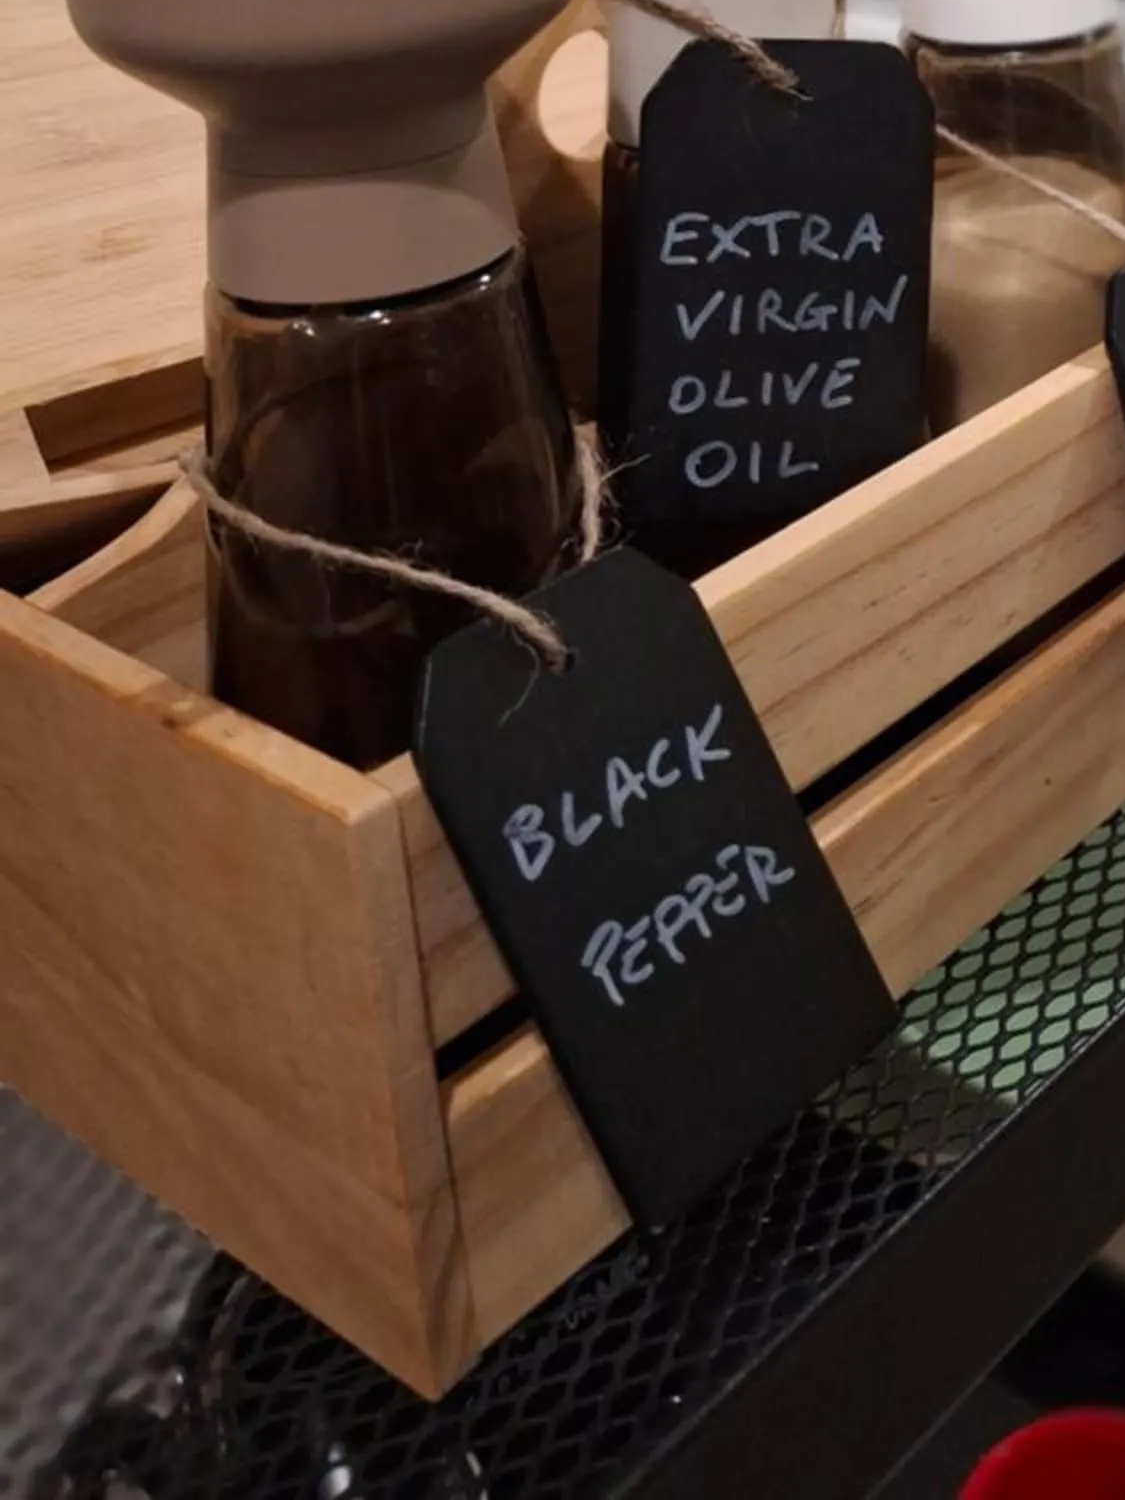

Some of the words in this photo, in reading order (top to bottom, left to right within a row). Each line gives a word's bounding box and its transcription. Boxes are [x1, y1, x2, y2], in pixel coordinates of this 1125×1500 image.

[660, 210, 884, 266] EXTRA
[676, 274, 908, 341] VIRGIN
[668, 357, 861, 414] OLIVE
[684, 440, 819, 488] OIL
[502, 703, 731, 882] BLACK
[580, 843, 796, 1007] PEPPER
